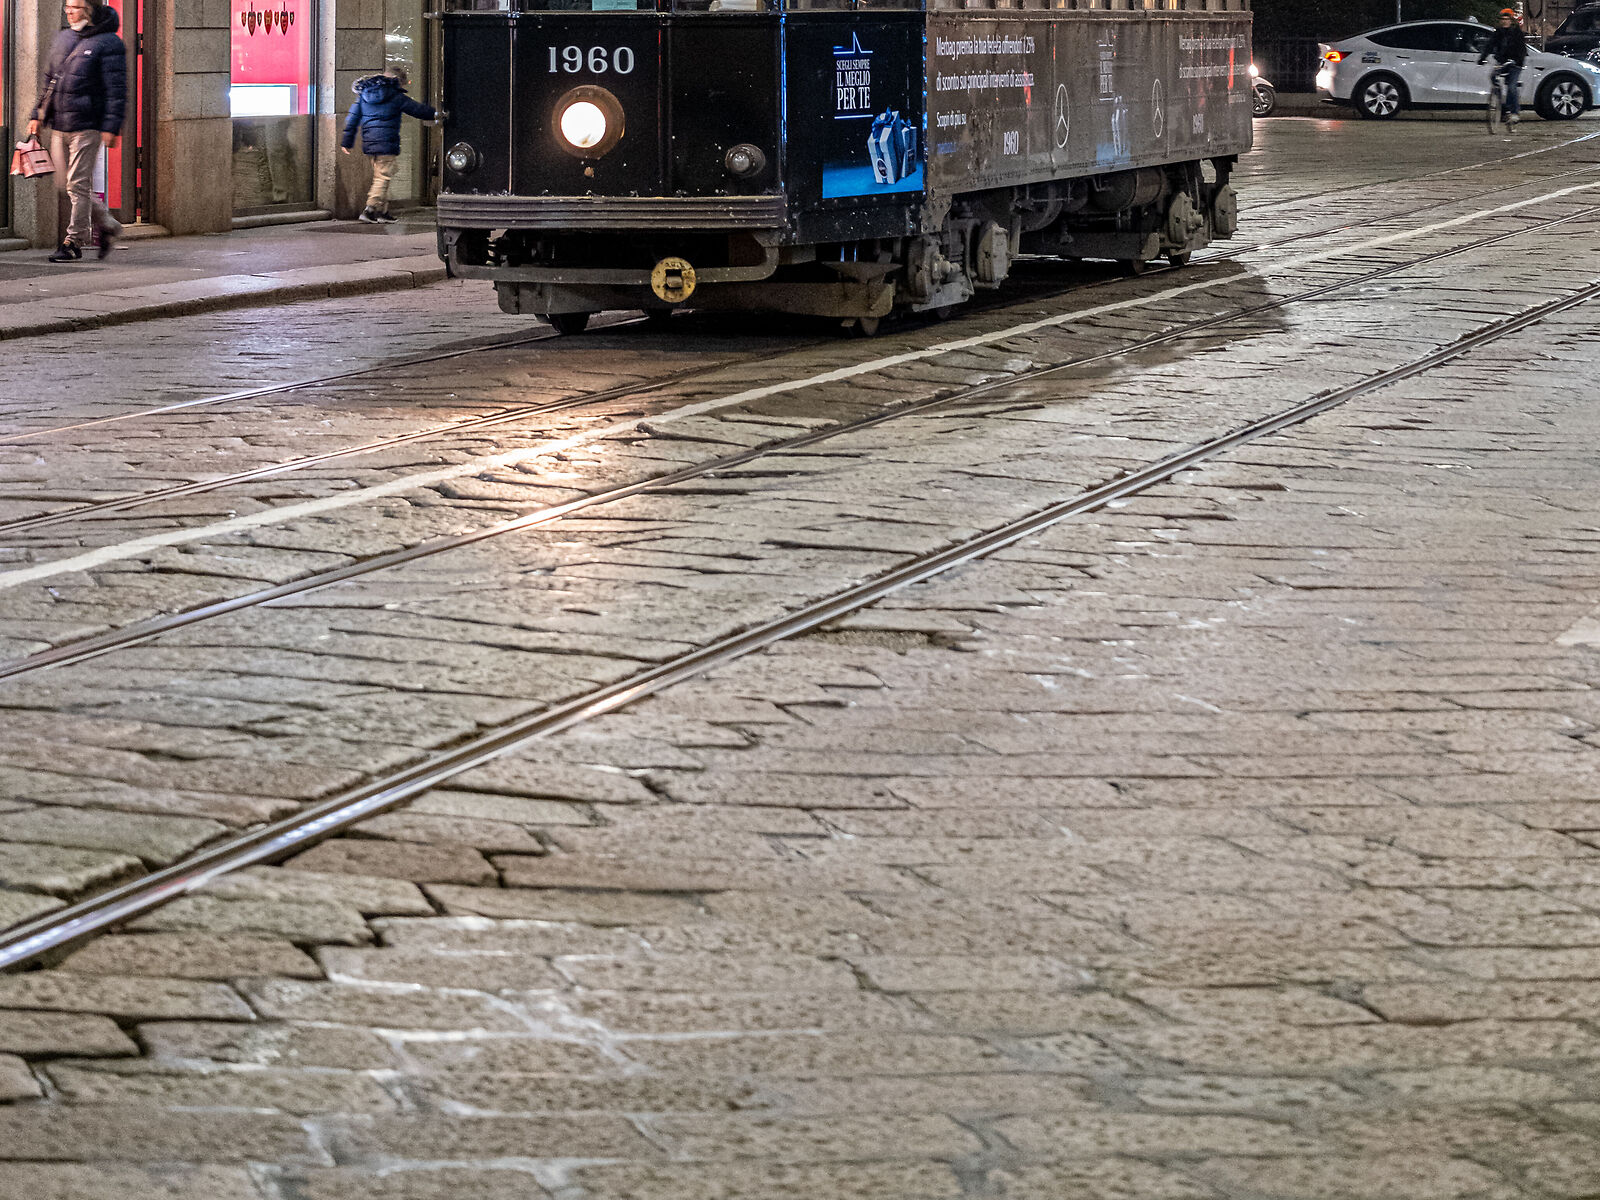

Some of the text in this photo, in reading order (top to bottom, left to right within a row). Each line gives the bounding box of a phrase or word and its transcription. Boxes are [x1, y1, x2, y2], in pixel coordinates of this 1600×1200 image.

[548, 45, 635, 75] 1960
[836, 59, 870, 70] SCEGLI SEMPRE
[836, 70, 870, 87] IL MEGLIO
[837, 86, 871, 110] PER TE
[1003, 131, 1019, 155] 1960
